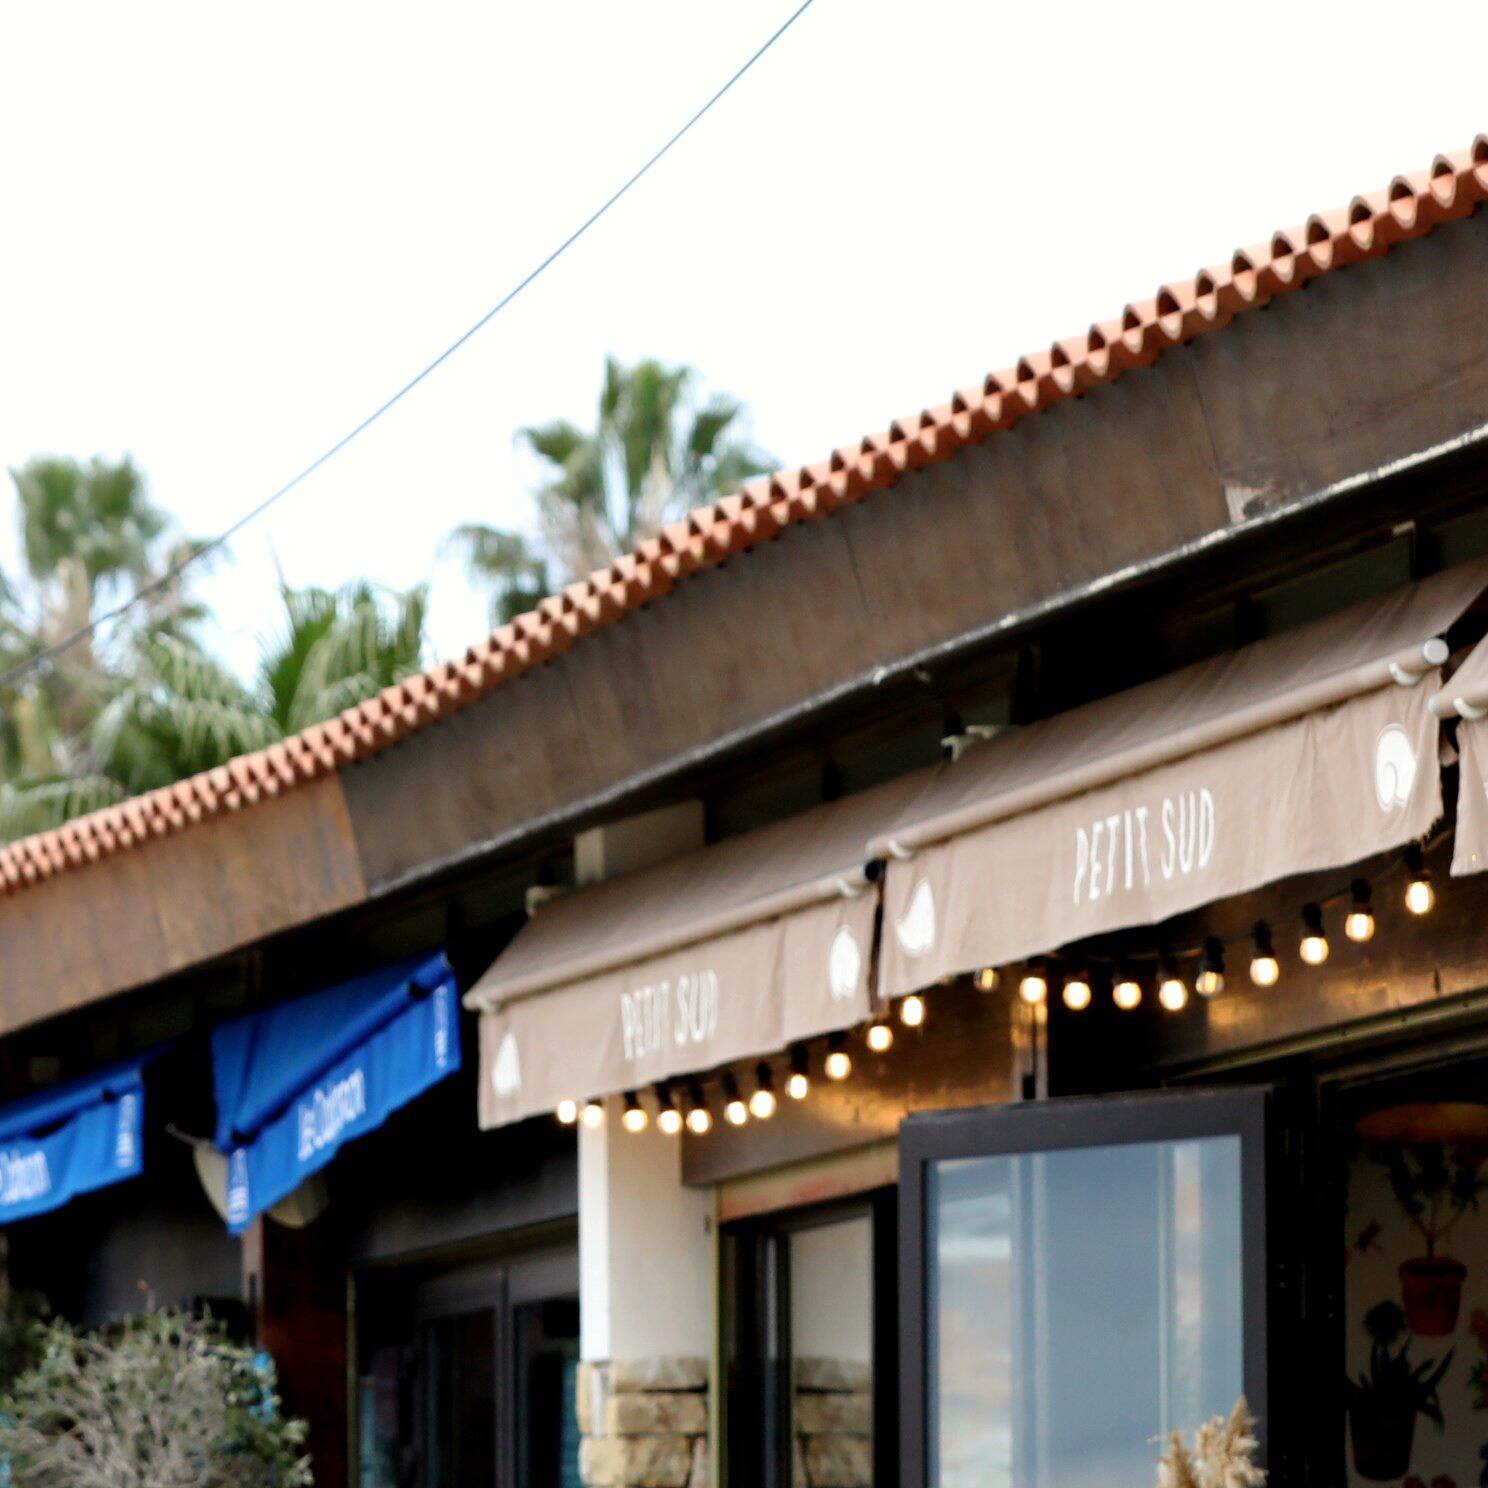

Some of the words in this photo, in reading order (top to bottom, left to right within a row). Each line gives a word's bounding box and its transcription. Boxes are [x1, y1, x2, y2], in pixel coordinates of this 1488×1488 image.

[1073, 806, 1150, 905] PETIT
[1161, 787, 1215, 879] SUD
[620, 980, 671, 1062] PETIT
[674, 969, 719, 1046] SUD
